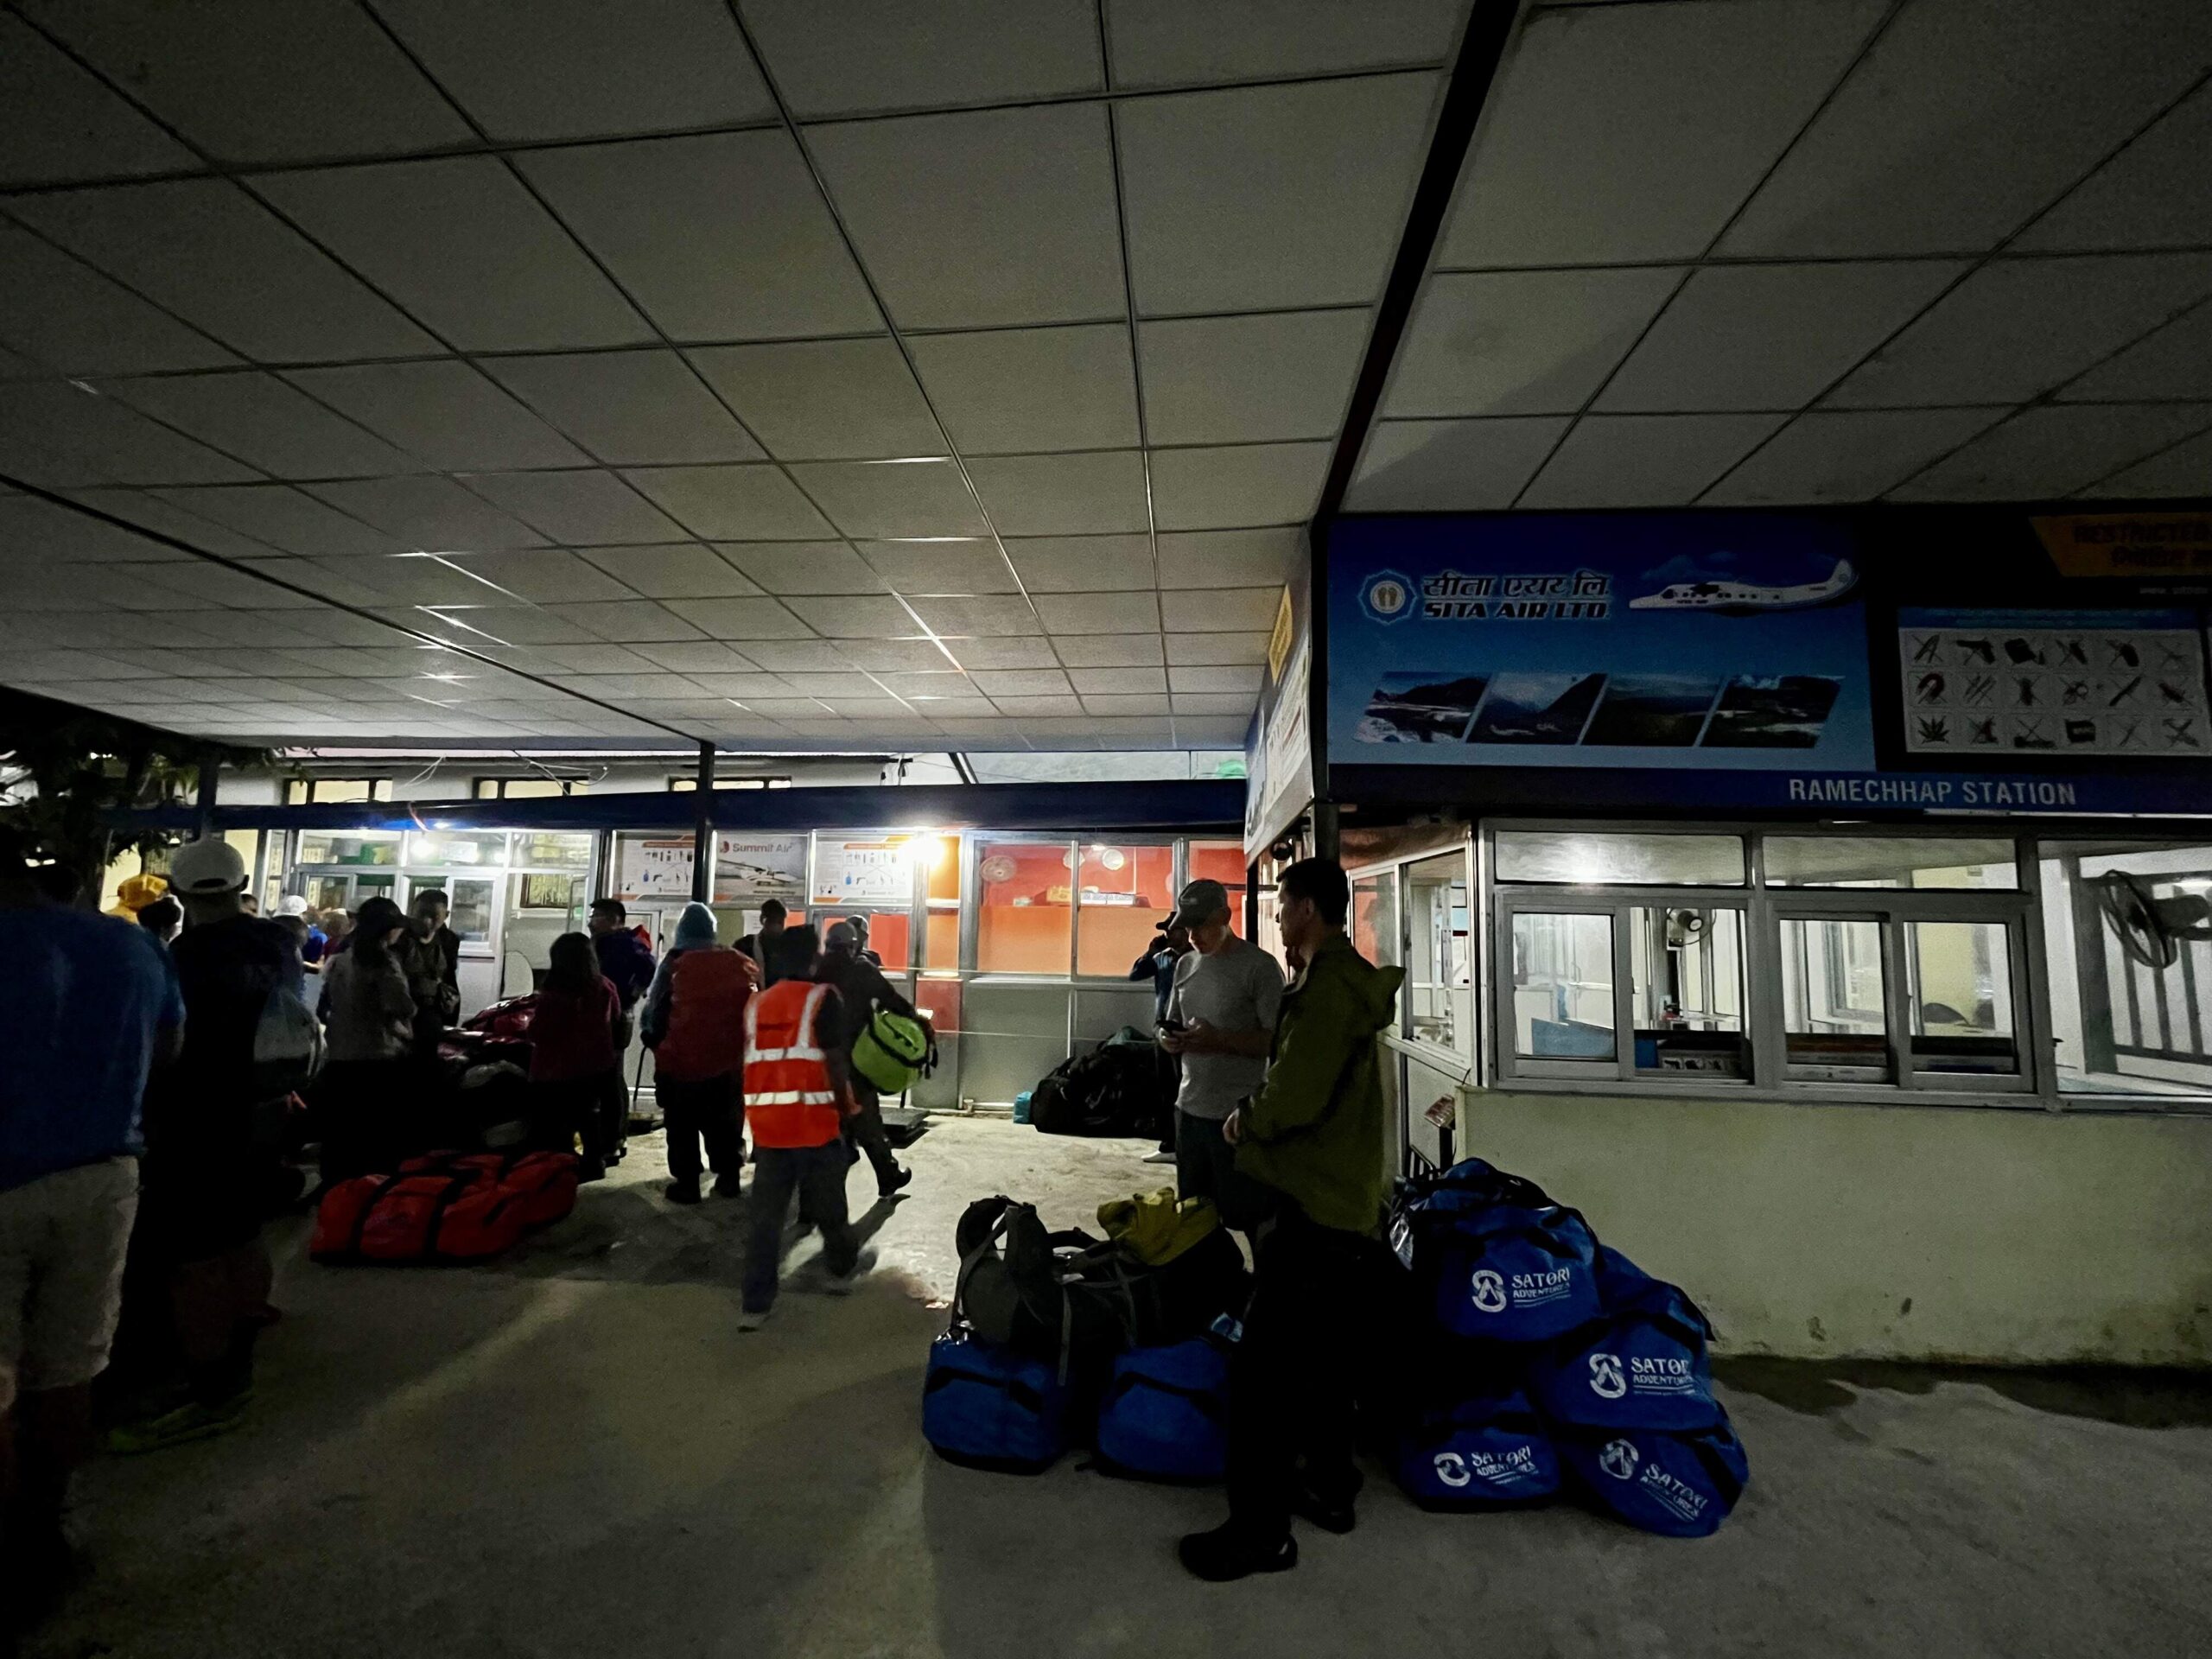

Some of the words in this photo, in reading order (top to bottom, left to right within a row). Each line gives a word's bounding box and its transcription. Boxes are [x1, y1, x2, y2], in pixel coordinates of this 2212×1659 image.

[1423, 602, 1486, 618] SITA
[1495, 602, 1548, 618] AIR
[1789, 779, 1952, 803] RAMECHHAP
[1961, 781, 2076, 804] STATION
[733, 843, 773, 853] Summit
[776, 843, 792, 853] Air
[1630, 1357, 1689, 1376] SATOR
[1476, 1460, 1536, 1477] ADVENTRES
